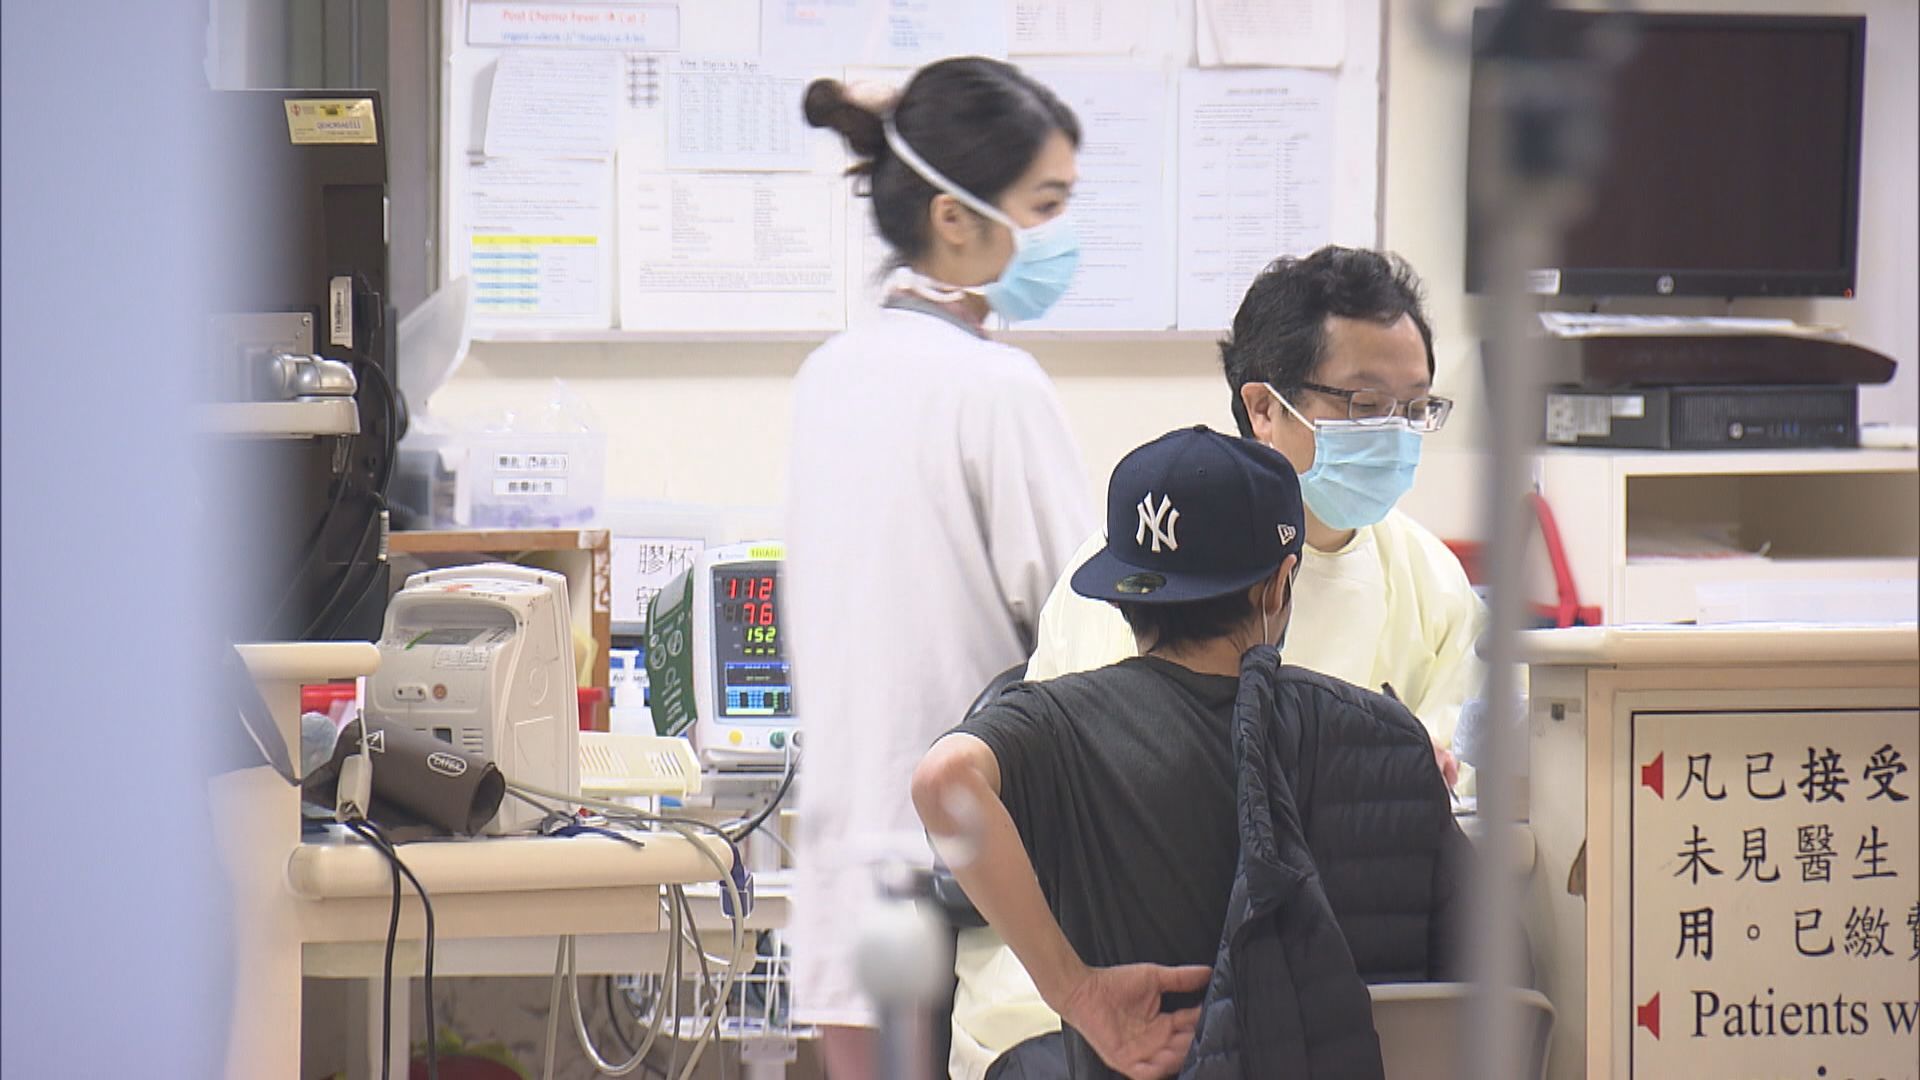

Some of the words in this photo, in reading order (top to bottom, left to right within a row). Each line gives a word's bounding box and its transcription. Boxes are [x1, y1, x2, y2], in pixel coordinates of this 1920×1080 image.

[1136, 491, 1181, 553] NY
[728, 577, 774, 600] 112
[743, 603, 774, 625] 76
[747, 626, 777, 643] 152
[1676, 744, 1910, 803] 凡已接受
[1673, 824, 1899, 885] 未見醫生
[1690, 988, 1869, 1037] Patients
